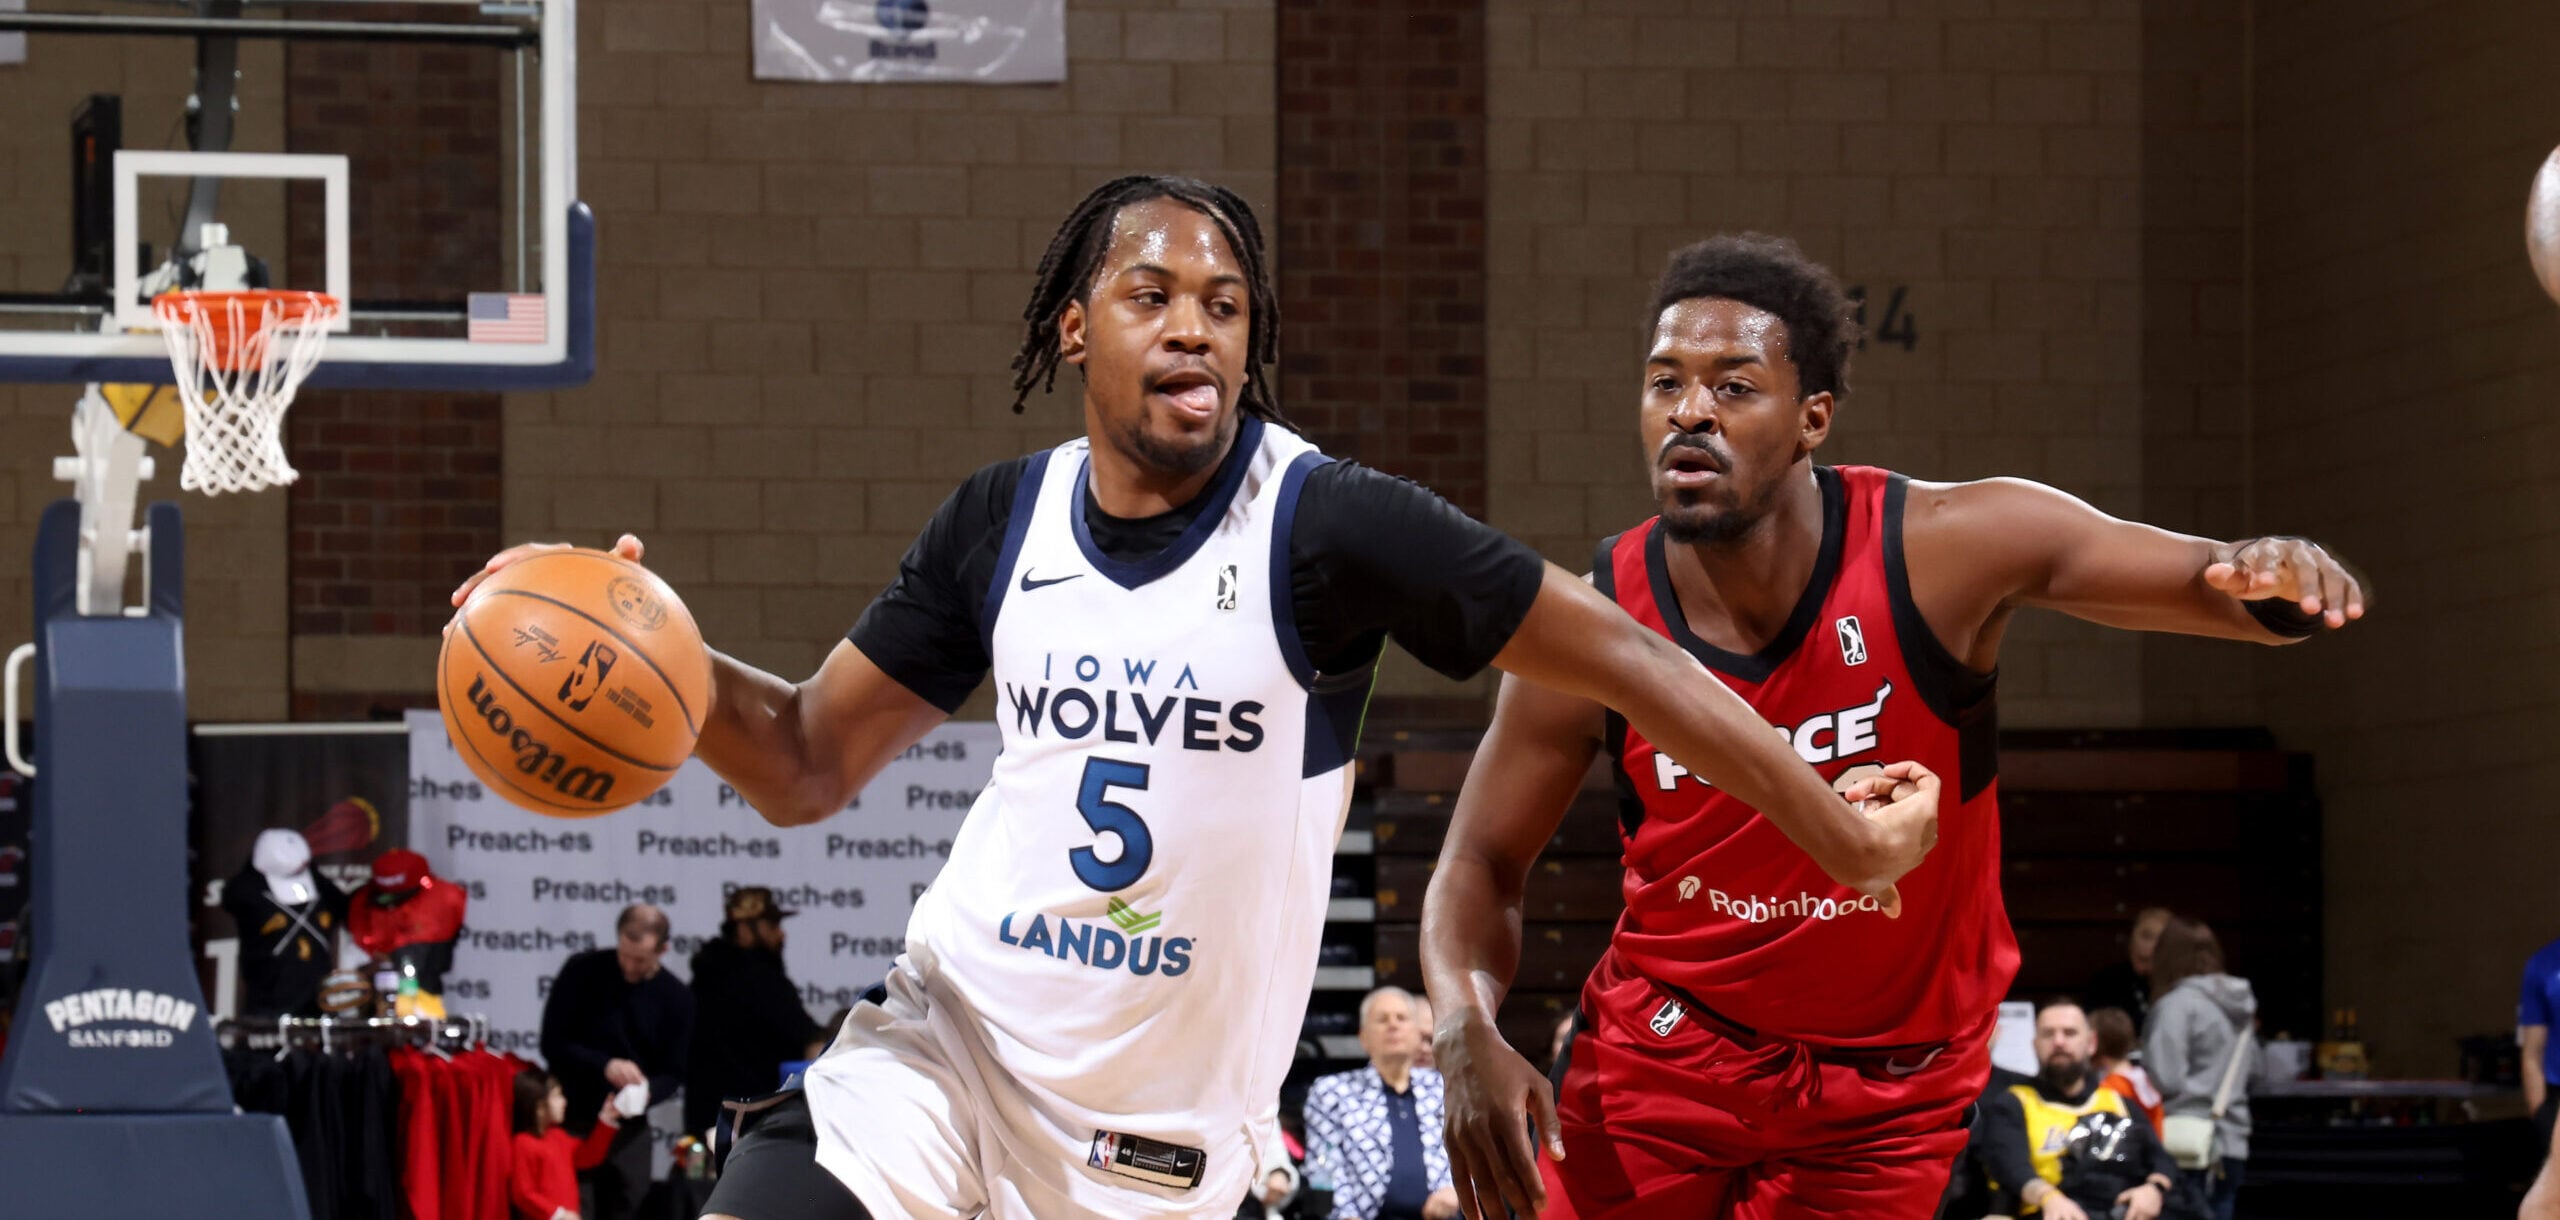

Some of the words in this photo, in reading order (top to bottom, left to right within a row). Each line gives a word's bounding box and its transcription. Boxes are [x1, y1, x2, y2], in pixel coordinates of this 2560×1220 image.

[1044, 652, 1199, 691] IOWA
[461, 671, 617, 803] Wilson
[1006, 681, 1265, 753] WOLVES
[1653, 676, 1893, 791] FCE
[446, 825, 593, 852] Preach-es
[637, 829, 781, 859] Preach-es
[826, 833, 954, 860] Preach-e
[1068, 755, 1154, 893] 5
[533, 877, 676, 904] Preach-es
[1000, 911, 1194, 977] LANDUS
[44, 987, 197, 1034] PENTAGON
[67, 1028, 174, 1049] SANFORD
